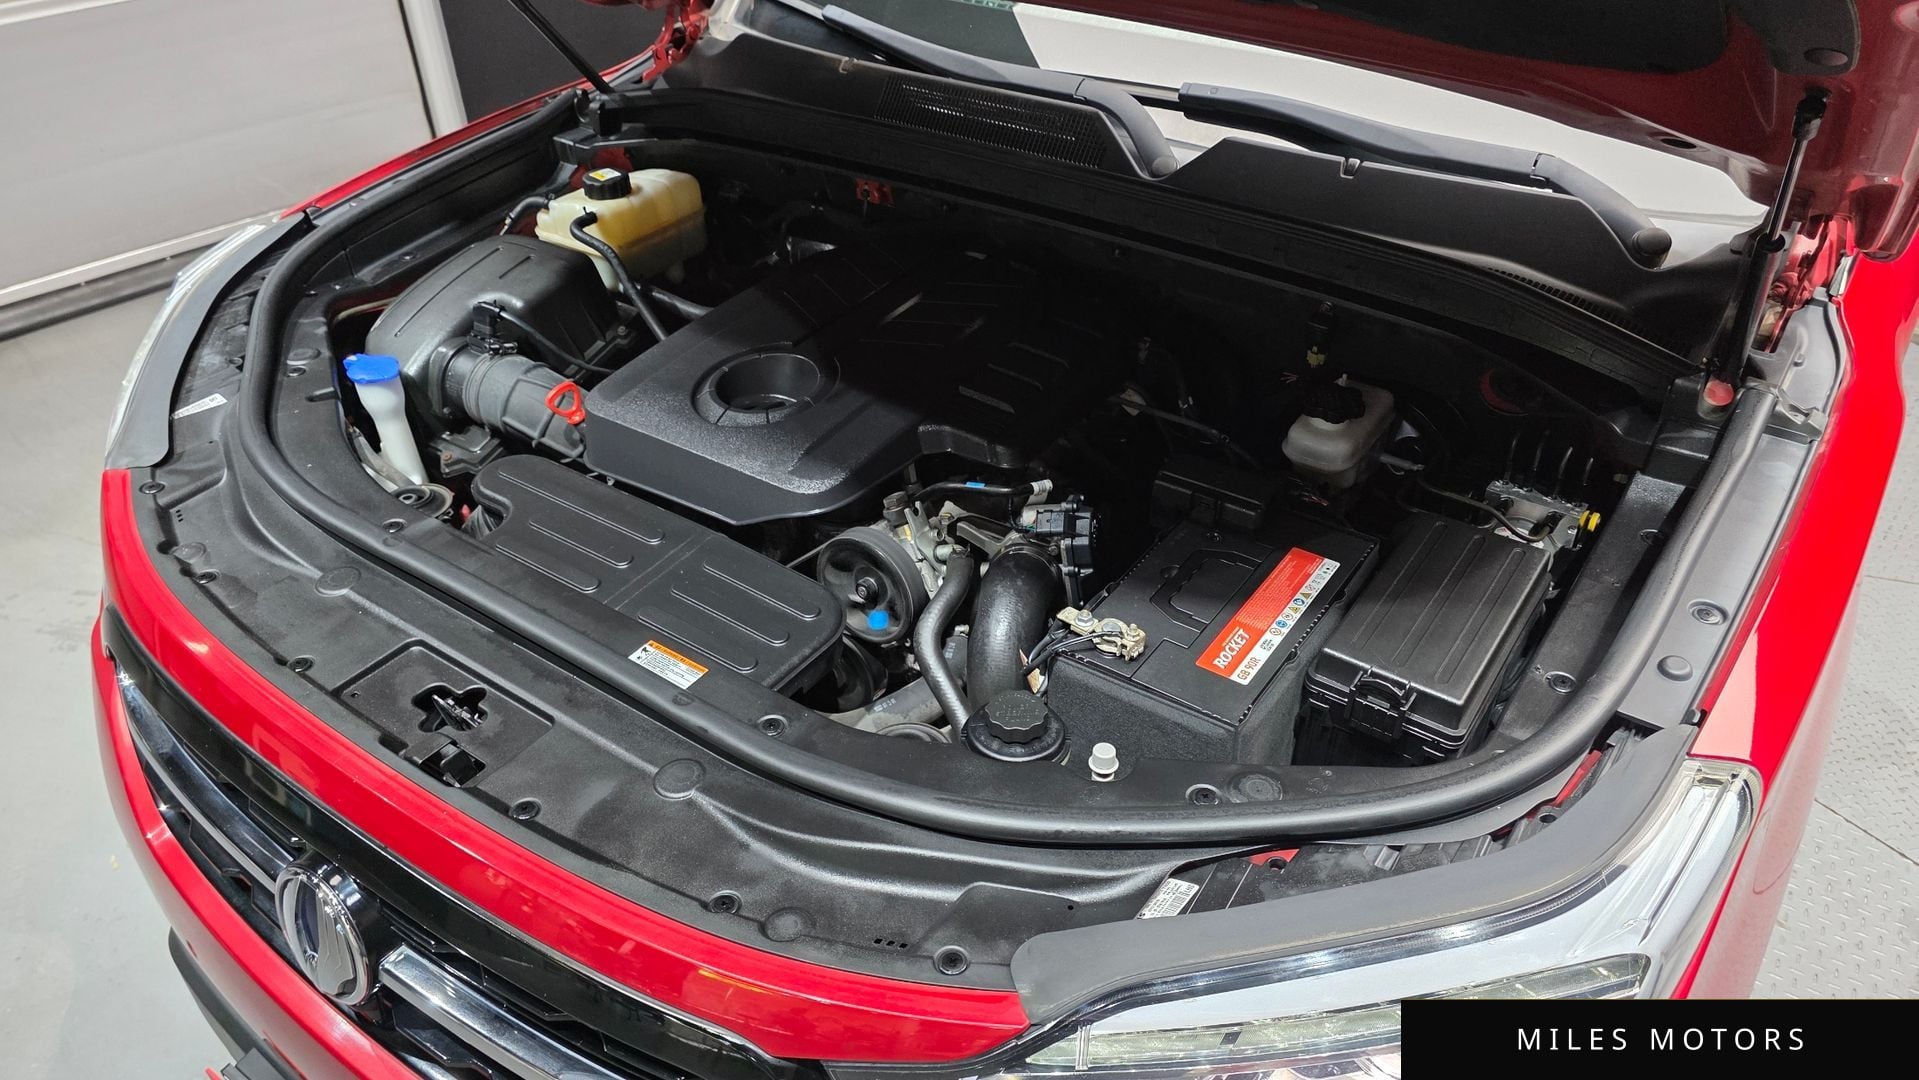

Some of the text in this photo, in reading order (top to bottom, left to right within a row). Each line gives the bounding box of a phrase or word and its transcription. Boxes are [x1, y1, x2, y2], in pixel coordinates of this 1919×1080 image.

[1212, 628, 1250, 669] ROCKET
[1237, 656, 1261, 681] GB 90R
